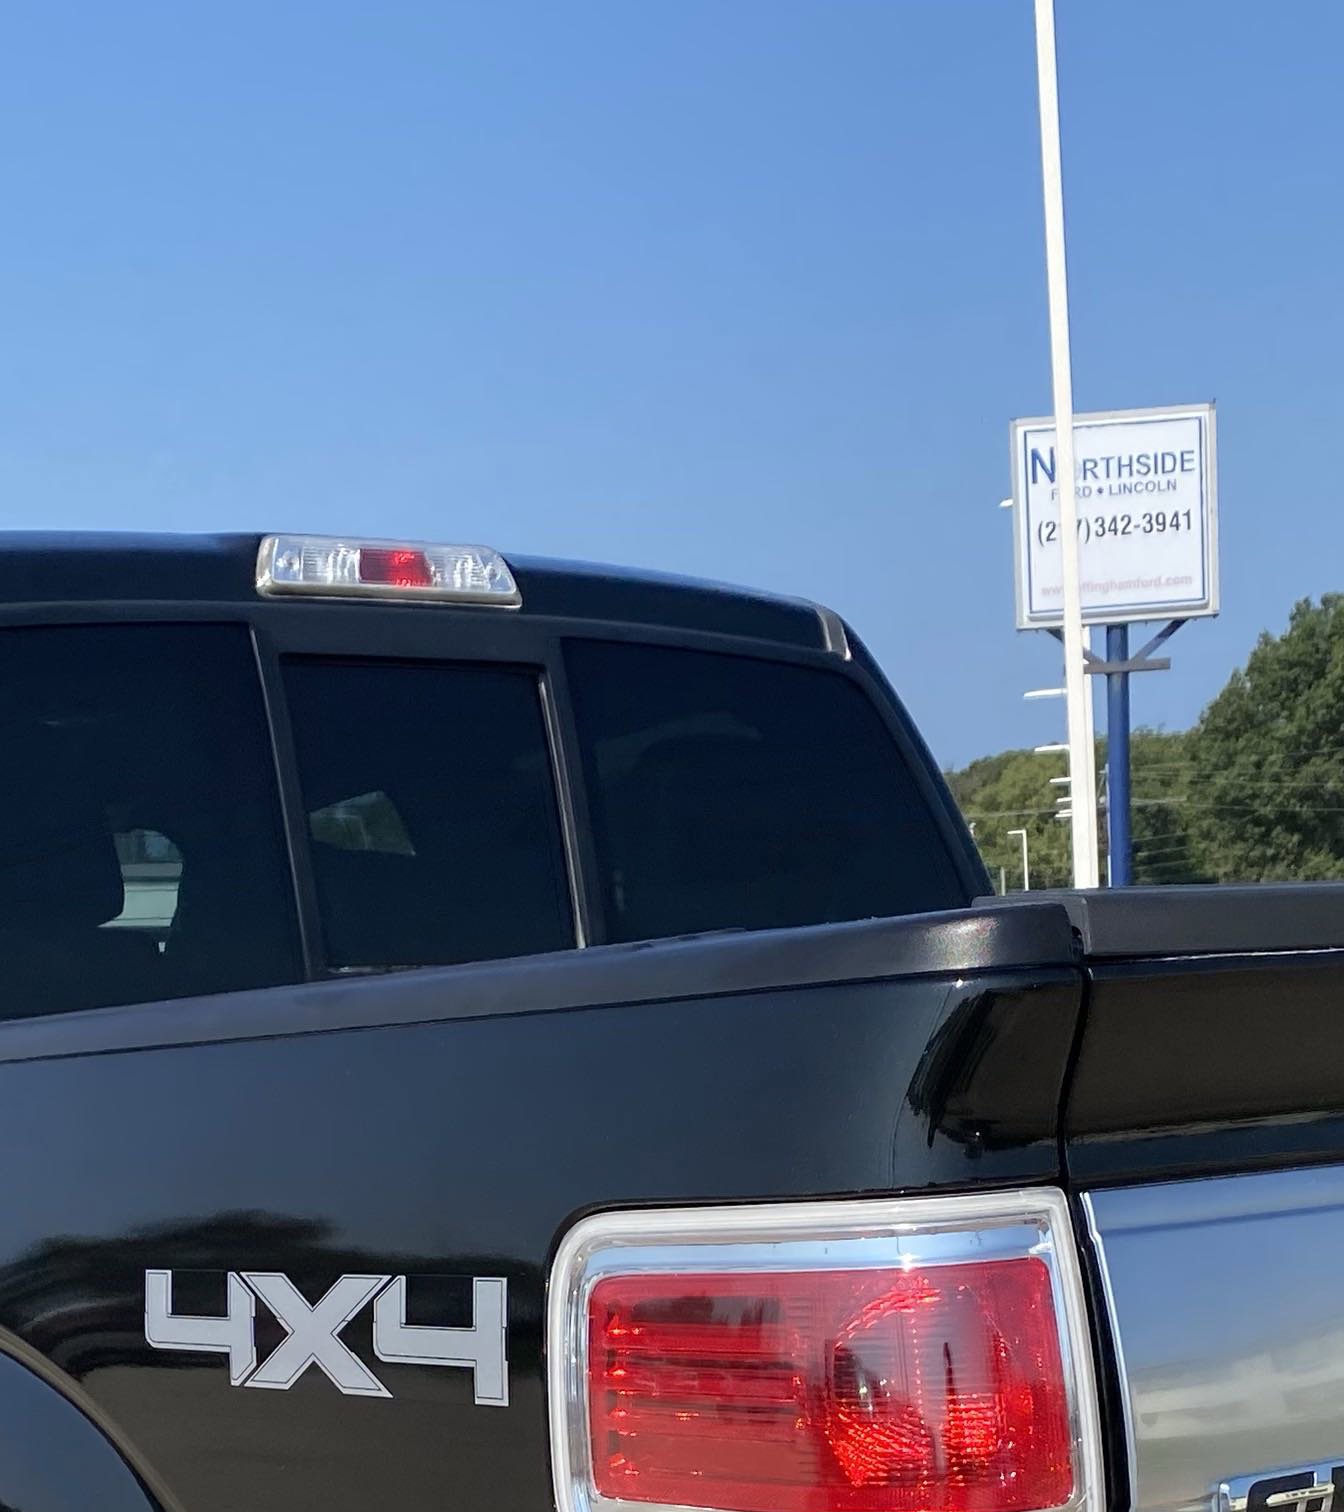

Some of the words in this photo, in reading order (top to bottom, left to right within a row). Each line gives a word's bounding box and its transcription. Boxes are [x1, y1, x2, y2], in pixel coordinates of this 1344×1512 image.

[1030, 447, 1195, 484] NRTHSIDE
[1051, 486, 1092, 500] FRD
[1109, 478, 1177, 496] LINCOLN
[145, 1269, 509, 1407] 4X4
